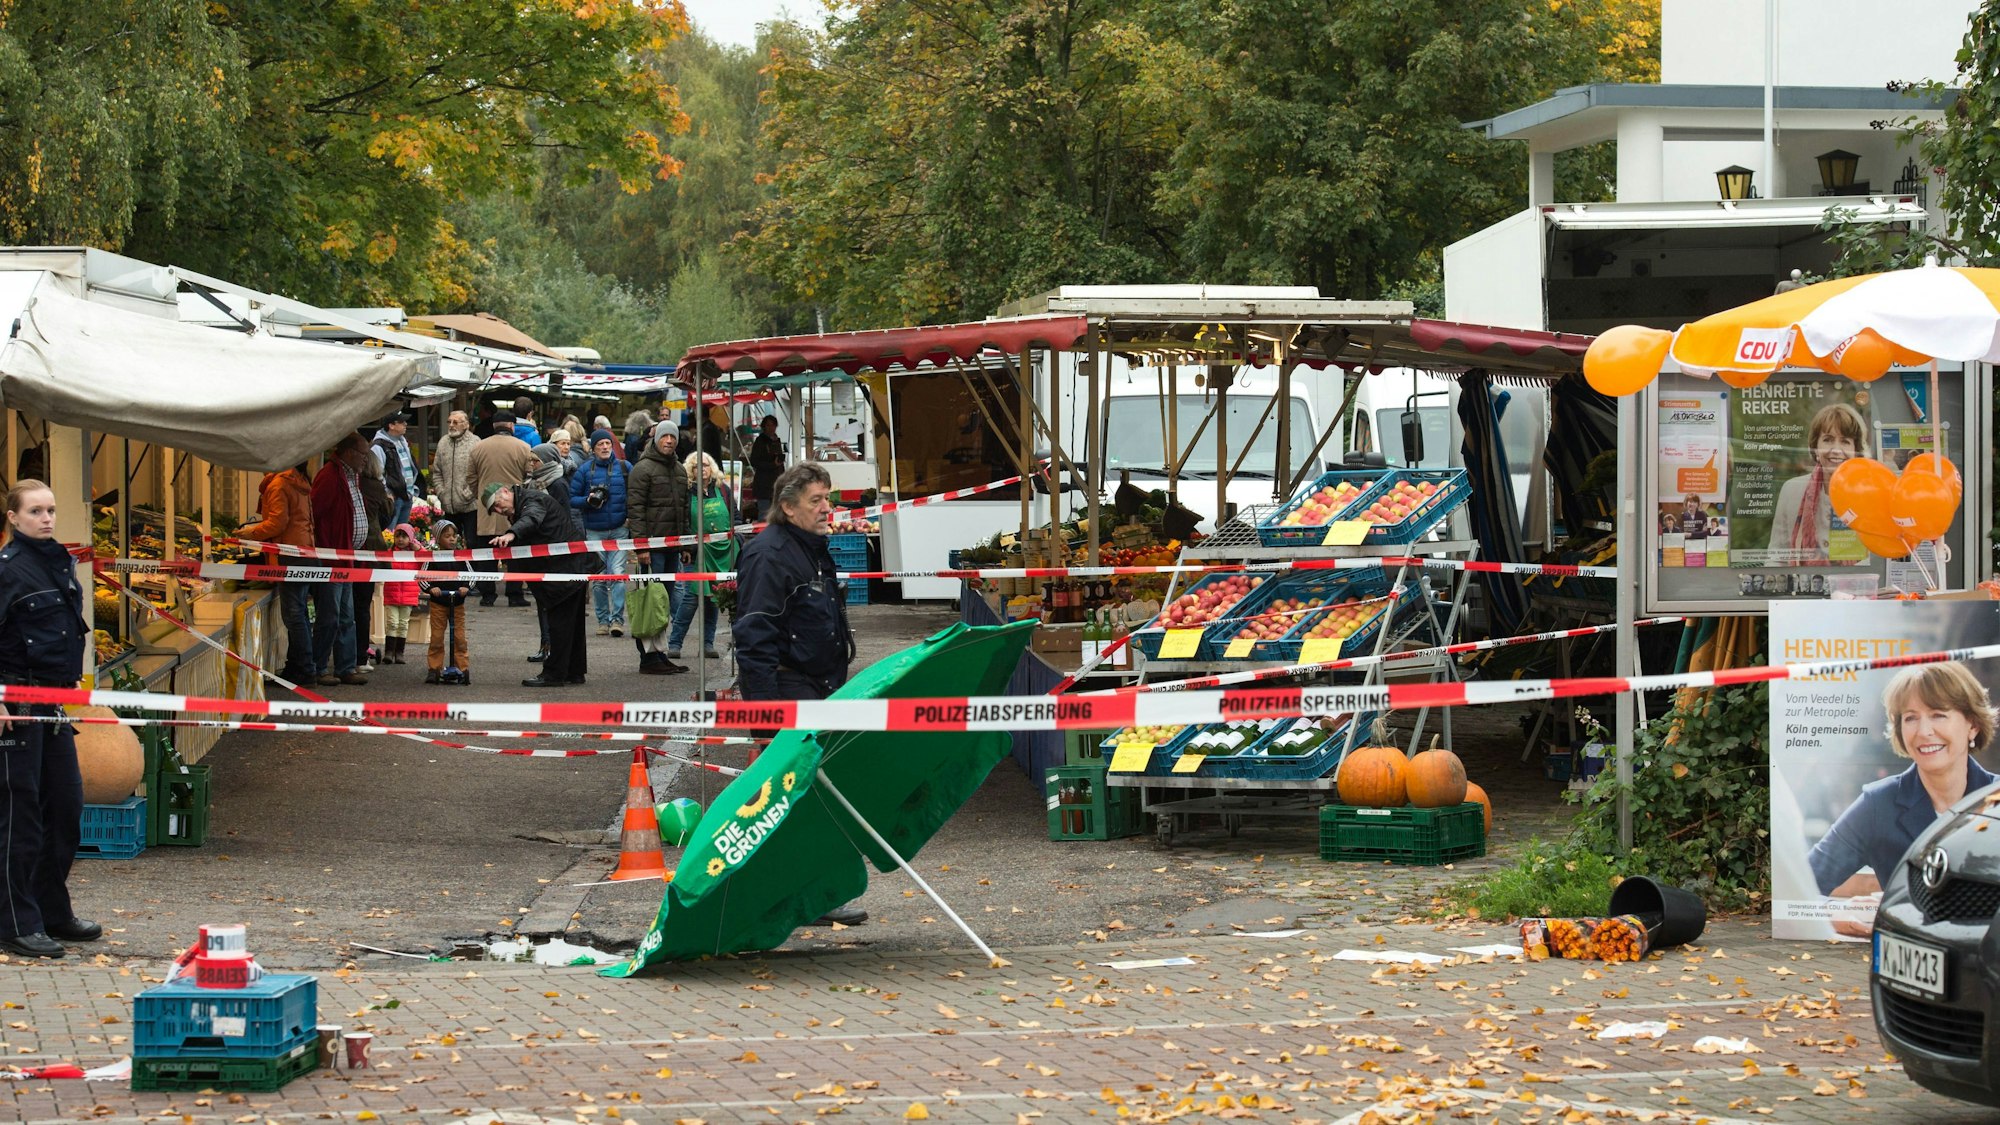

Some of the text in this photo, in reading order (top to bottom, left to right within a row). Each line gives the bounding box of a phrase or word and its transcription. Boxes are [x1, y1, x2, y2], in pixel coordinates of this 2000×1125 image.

[1740, 341, 1777, 360] CDU
[1741, 384, 1824, 399] HENRIETTE
[1742, 401, 1790, 415] REKER
[258, 568, 349, 581] POLIZEIABSPERRUNG
[1785, 639, 1914, 659] HENRIETTE
[1218, 692, 1392, 715] POLIZEIABSPERRUNG
[1785, 693, 1861, 705] Vom Veedel bis
[601, 708, 785, 725] POLIZEIABSPERRUNG
[914, 701, 1093, 723] POLIZEIABSPERRUNG
[1785, 706, 1859, 720] zur Metropole:
[1786, 724, 1869, 738] Köln gemeinsam
[1786, 737, 1823, 749] planen.
[714, 821, 745, 855] DIE
[725, 795, 790, 866] GRÜNEN
[1883, 940, 1890, 973] K
[1914, 949, 1939, 986] 213
